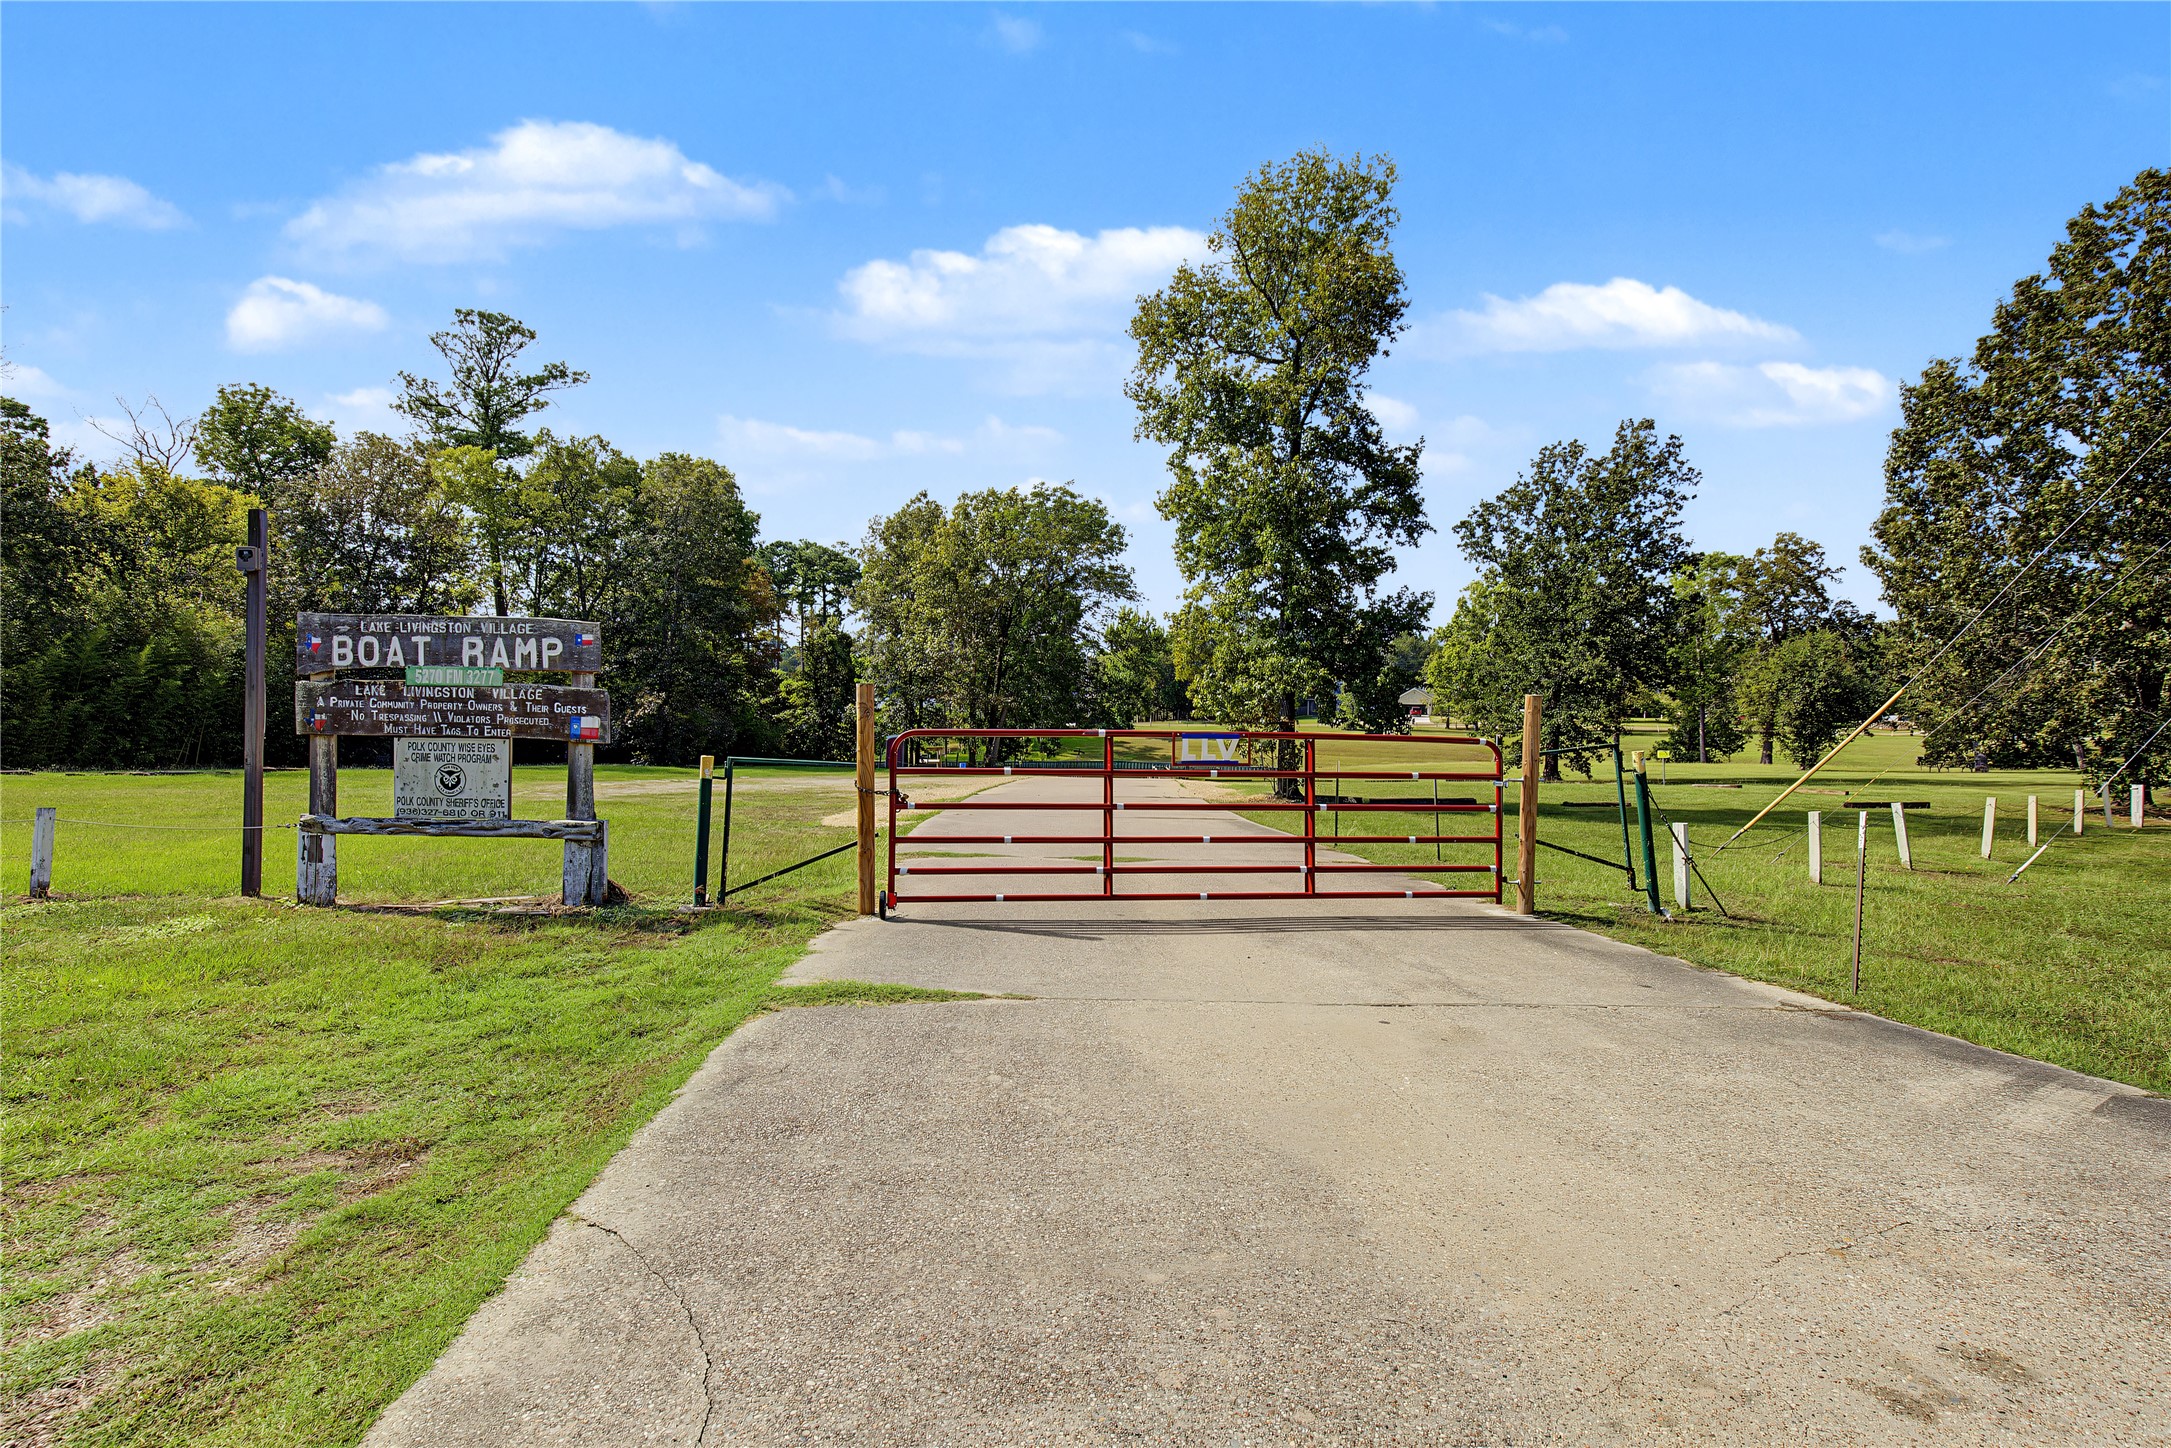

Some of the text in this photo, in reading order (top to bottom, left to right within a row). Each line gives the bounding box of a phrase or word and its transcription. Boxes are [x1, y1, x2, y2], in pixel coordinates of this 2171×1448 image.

[361, 620, 534, 635] LAKE LIVINGSTON VILLAGE
[332, 635, 563, 669] BOAT RAMP
[415, 669, 495, 684] 5270 FM 3277
[355, 684, 543, 700] LAKE LIVINGSTON VILLAGE
[316, 696, 325, 708] A
[509, 701, 518, 712] &
[407, 741, 496, 753] POLK COUNTY WISE EYES
[1181, 738, 1240, 761] LLV
[410, 752, 492, 764] CRIME WATCH PROGRAM
[396, 796, 505, 809] POLK COUNTY SHERIFF'S OFFICE
[470, 810, 486, 818] OR
[489, 810, 506, 818] 911
